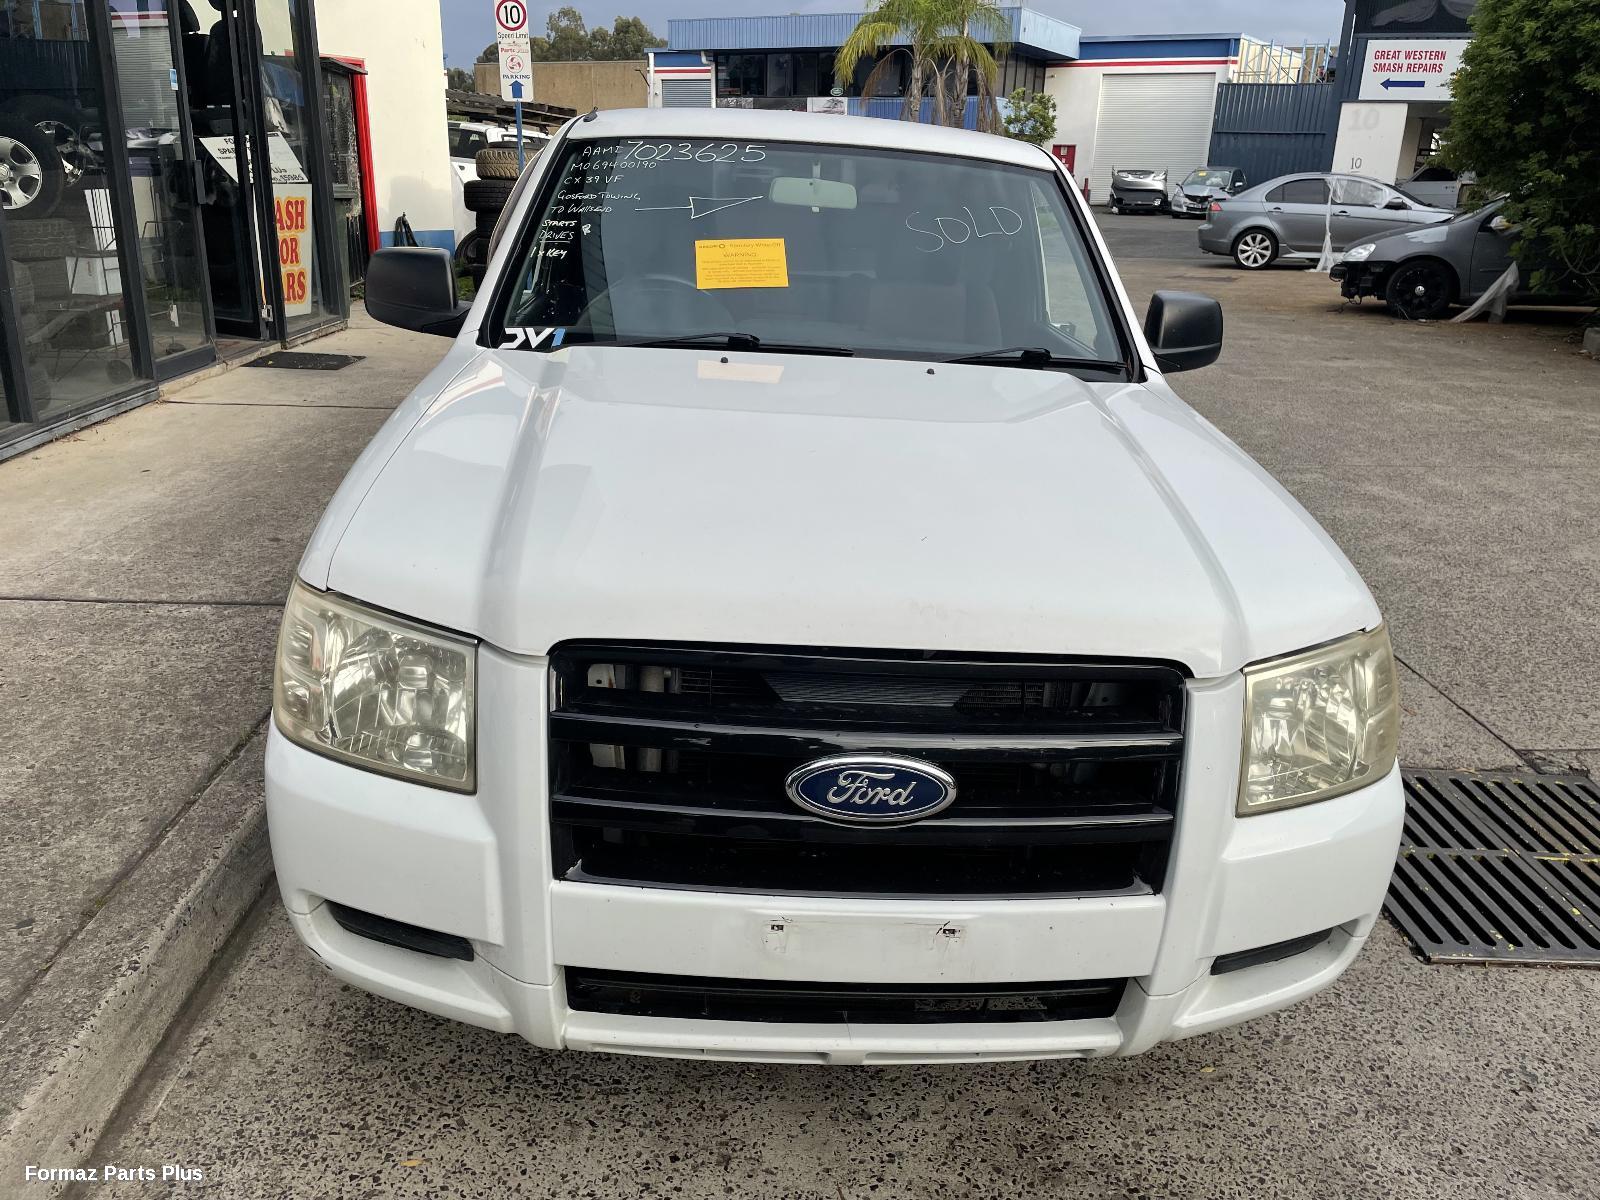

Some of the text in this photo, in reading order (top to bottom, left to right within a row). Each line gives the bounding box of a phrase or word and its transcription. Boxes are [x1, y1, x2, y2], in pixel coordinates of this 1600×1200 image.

[503, 5, 521, 24] 10
[497, 31, 529, 40] Speed Limit
[1374, 50, 1447, 61] GREAT WESTERN
[1372, 62, 1444, 73] SMASH REPAIRS
[624, 140, 766, 163] 7023625
[1350, 155, 1363, 170] 10
[275, 199, 306, 232] ASH
[542, 219, 578, 228] STARTS
[905, 206, 1023, 253] SOLD
[539, 230, 575, 240] DRIVES
[279, 237, 300, 266] OR
[546, 248, 568, 260] KEY
[826, 769, 918, 806] Ford
